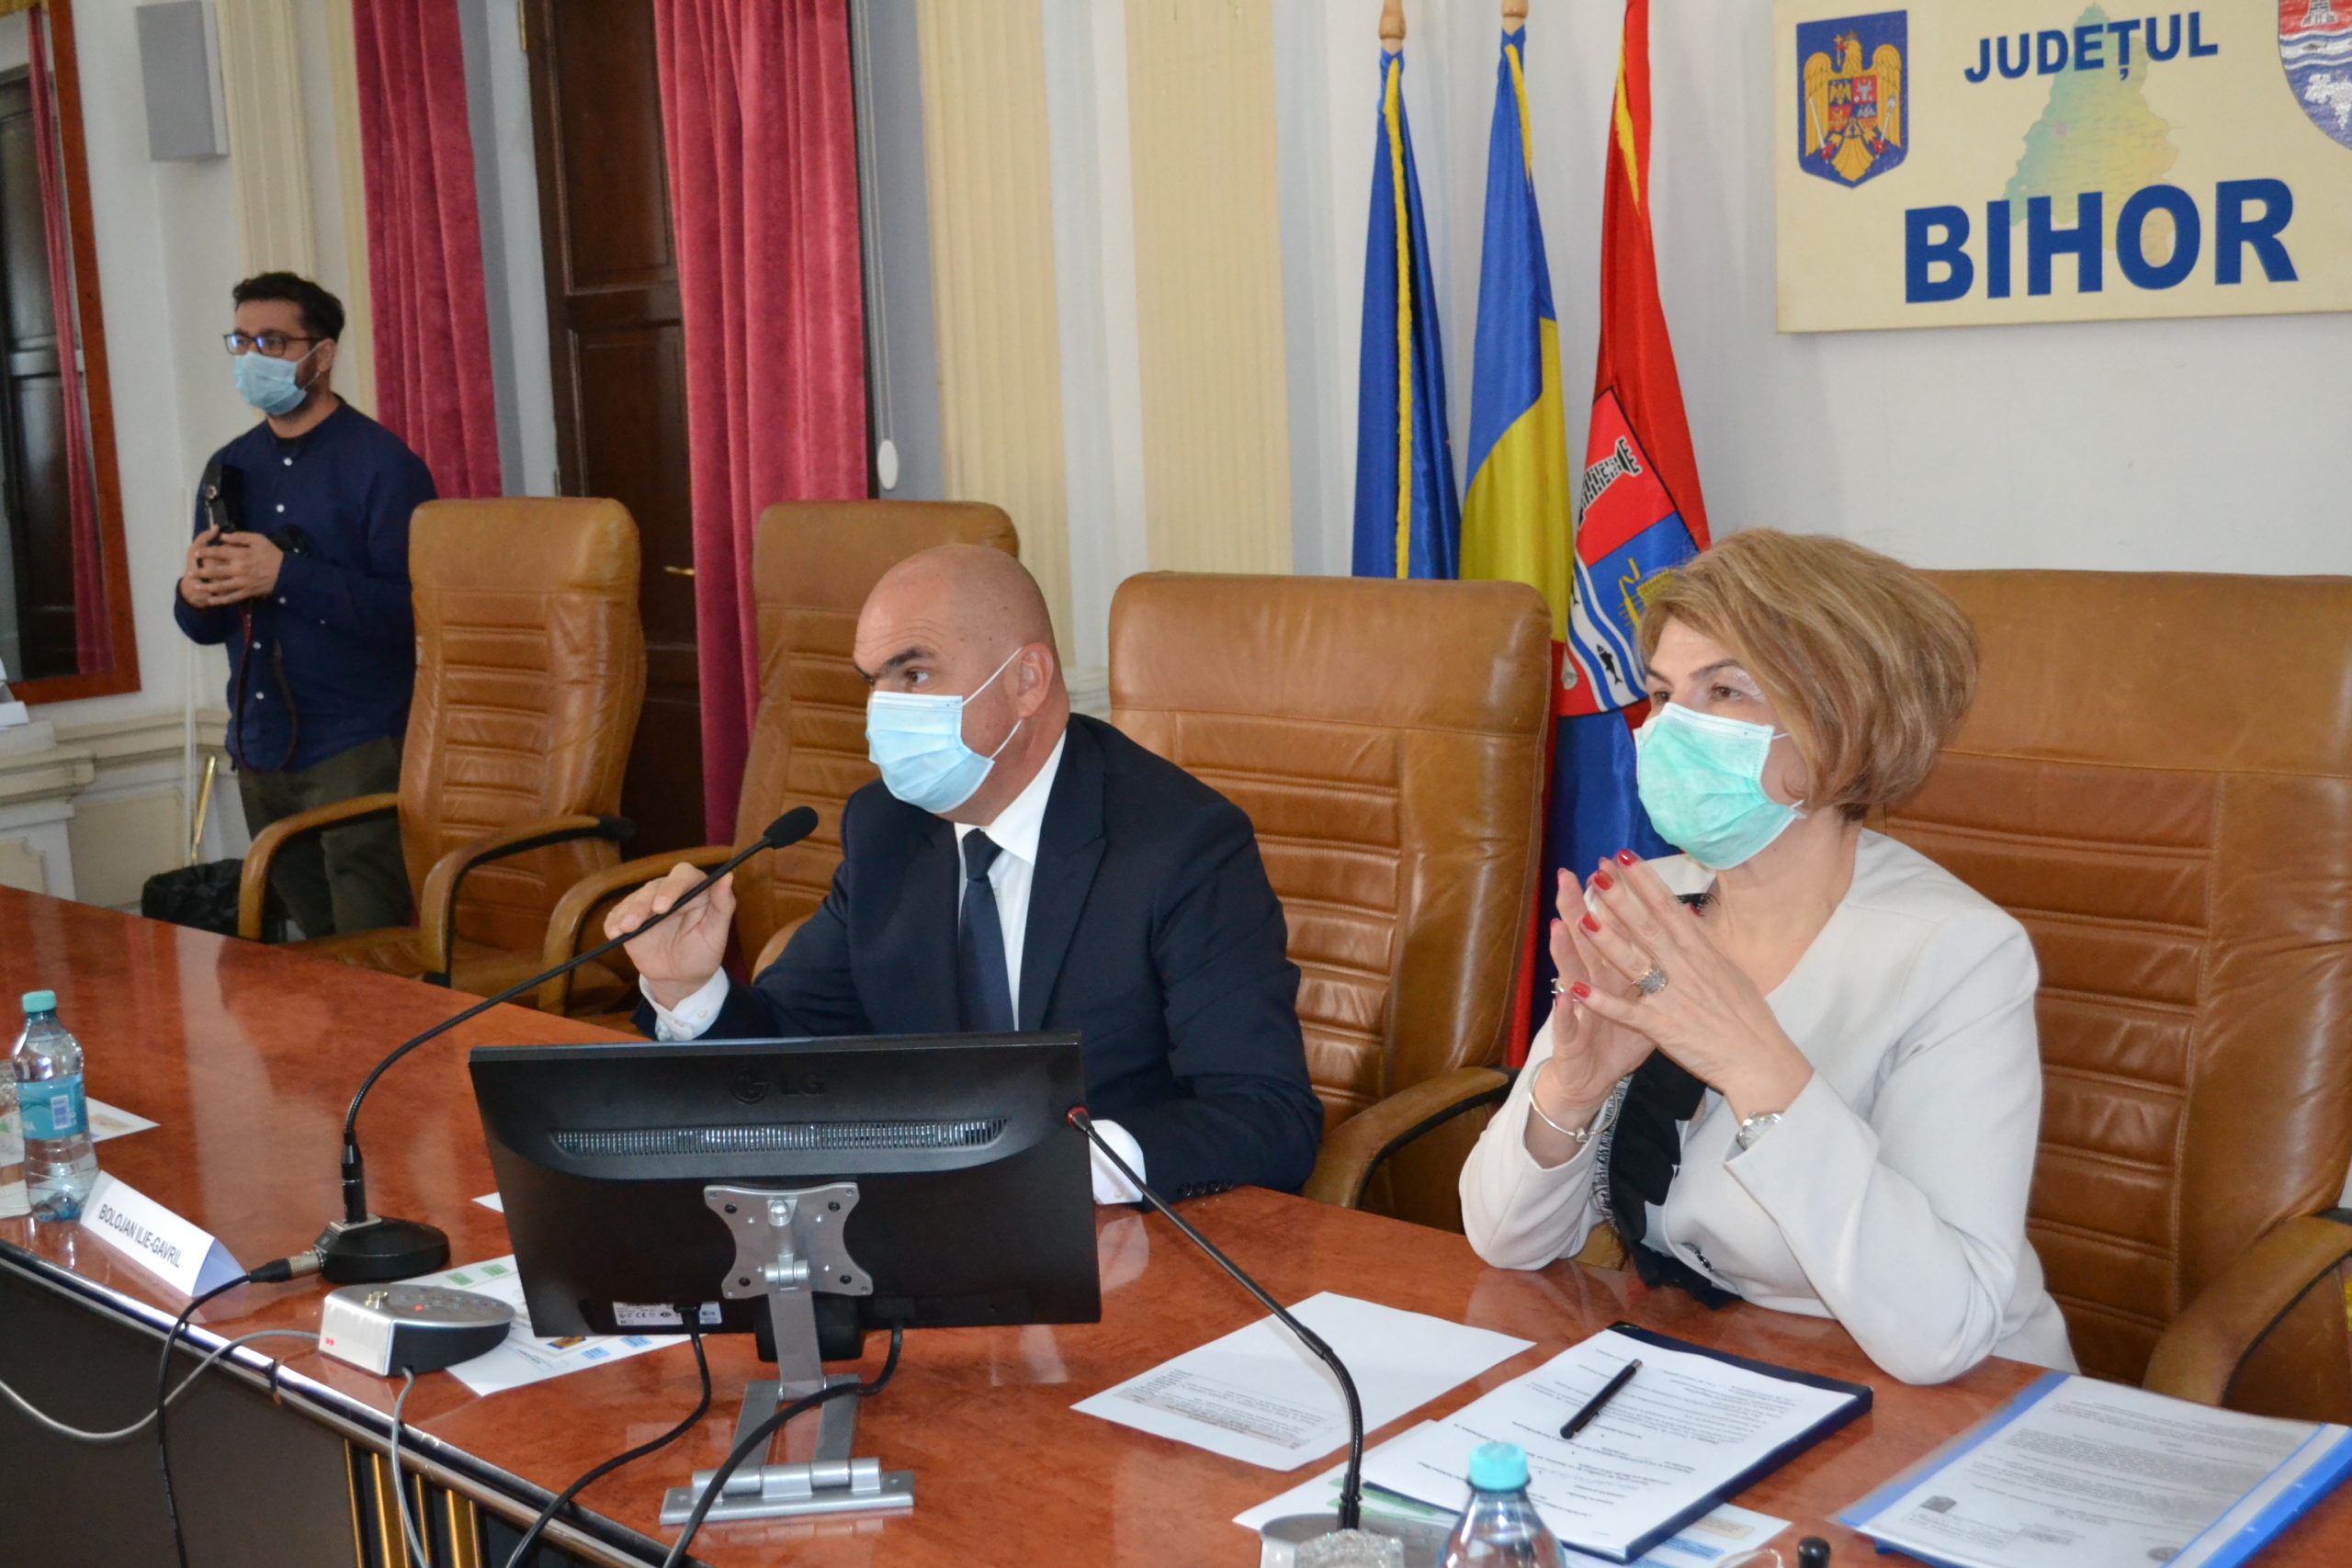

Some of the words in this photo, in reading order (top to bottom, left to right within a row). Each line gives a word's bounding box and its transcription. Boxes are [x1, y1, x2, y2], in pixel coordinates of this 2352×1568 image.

[1963, 12, 2218, 83] JUDEȚUL
[1905, 178, 2299, 304] BIHOR
[780, 1073, 825, 1095] LG
[99, 1204, 138, 1238] BOLOJAN
[136, 1226, 181, 1268] ILIE-GAVRIL
